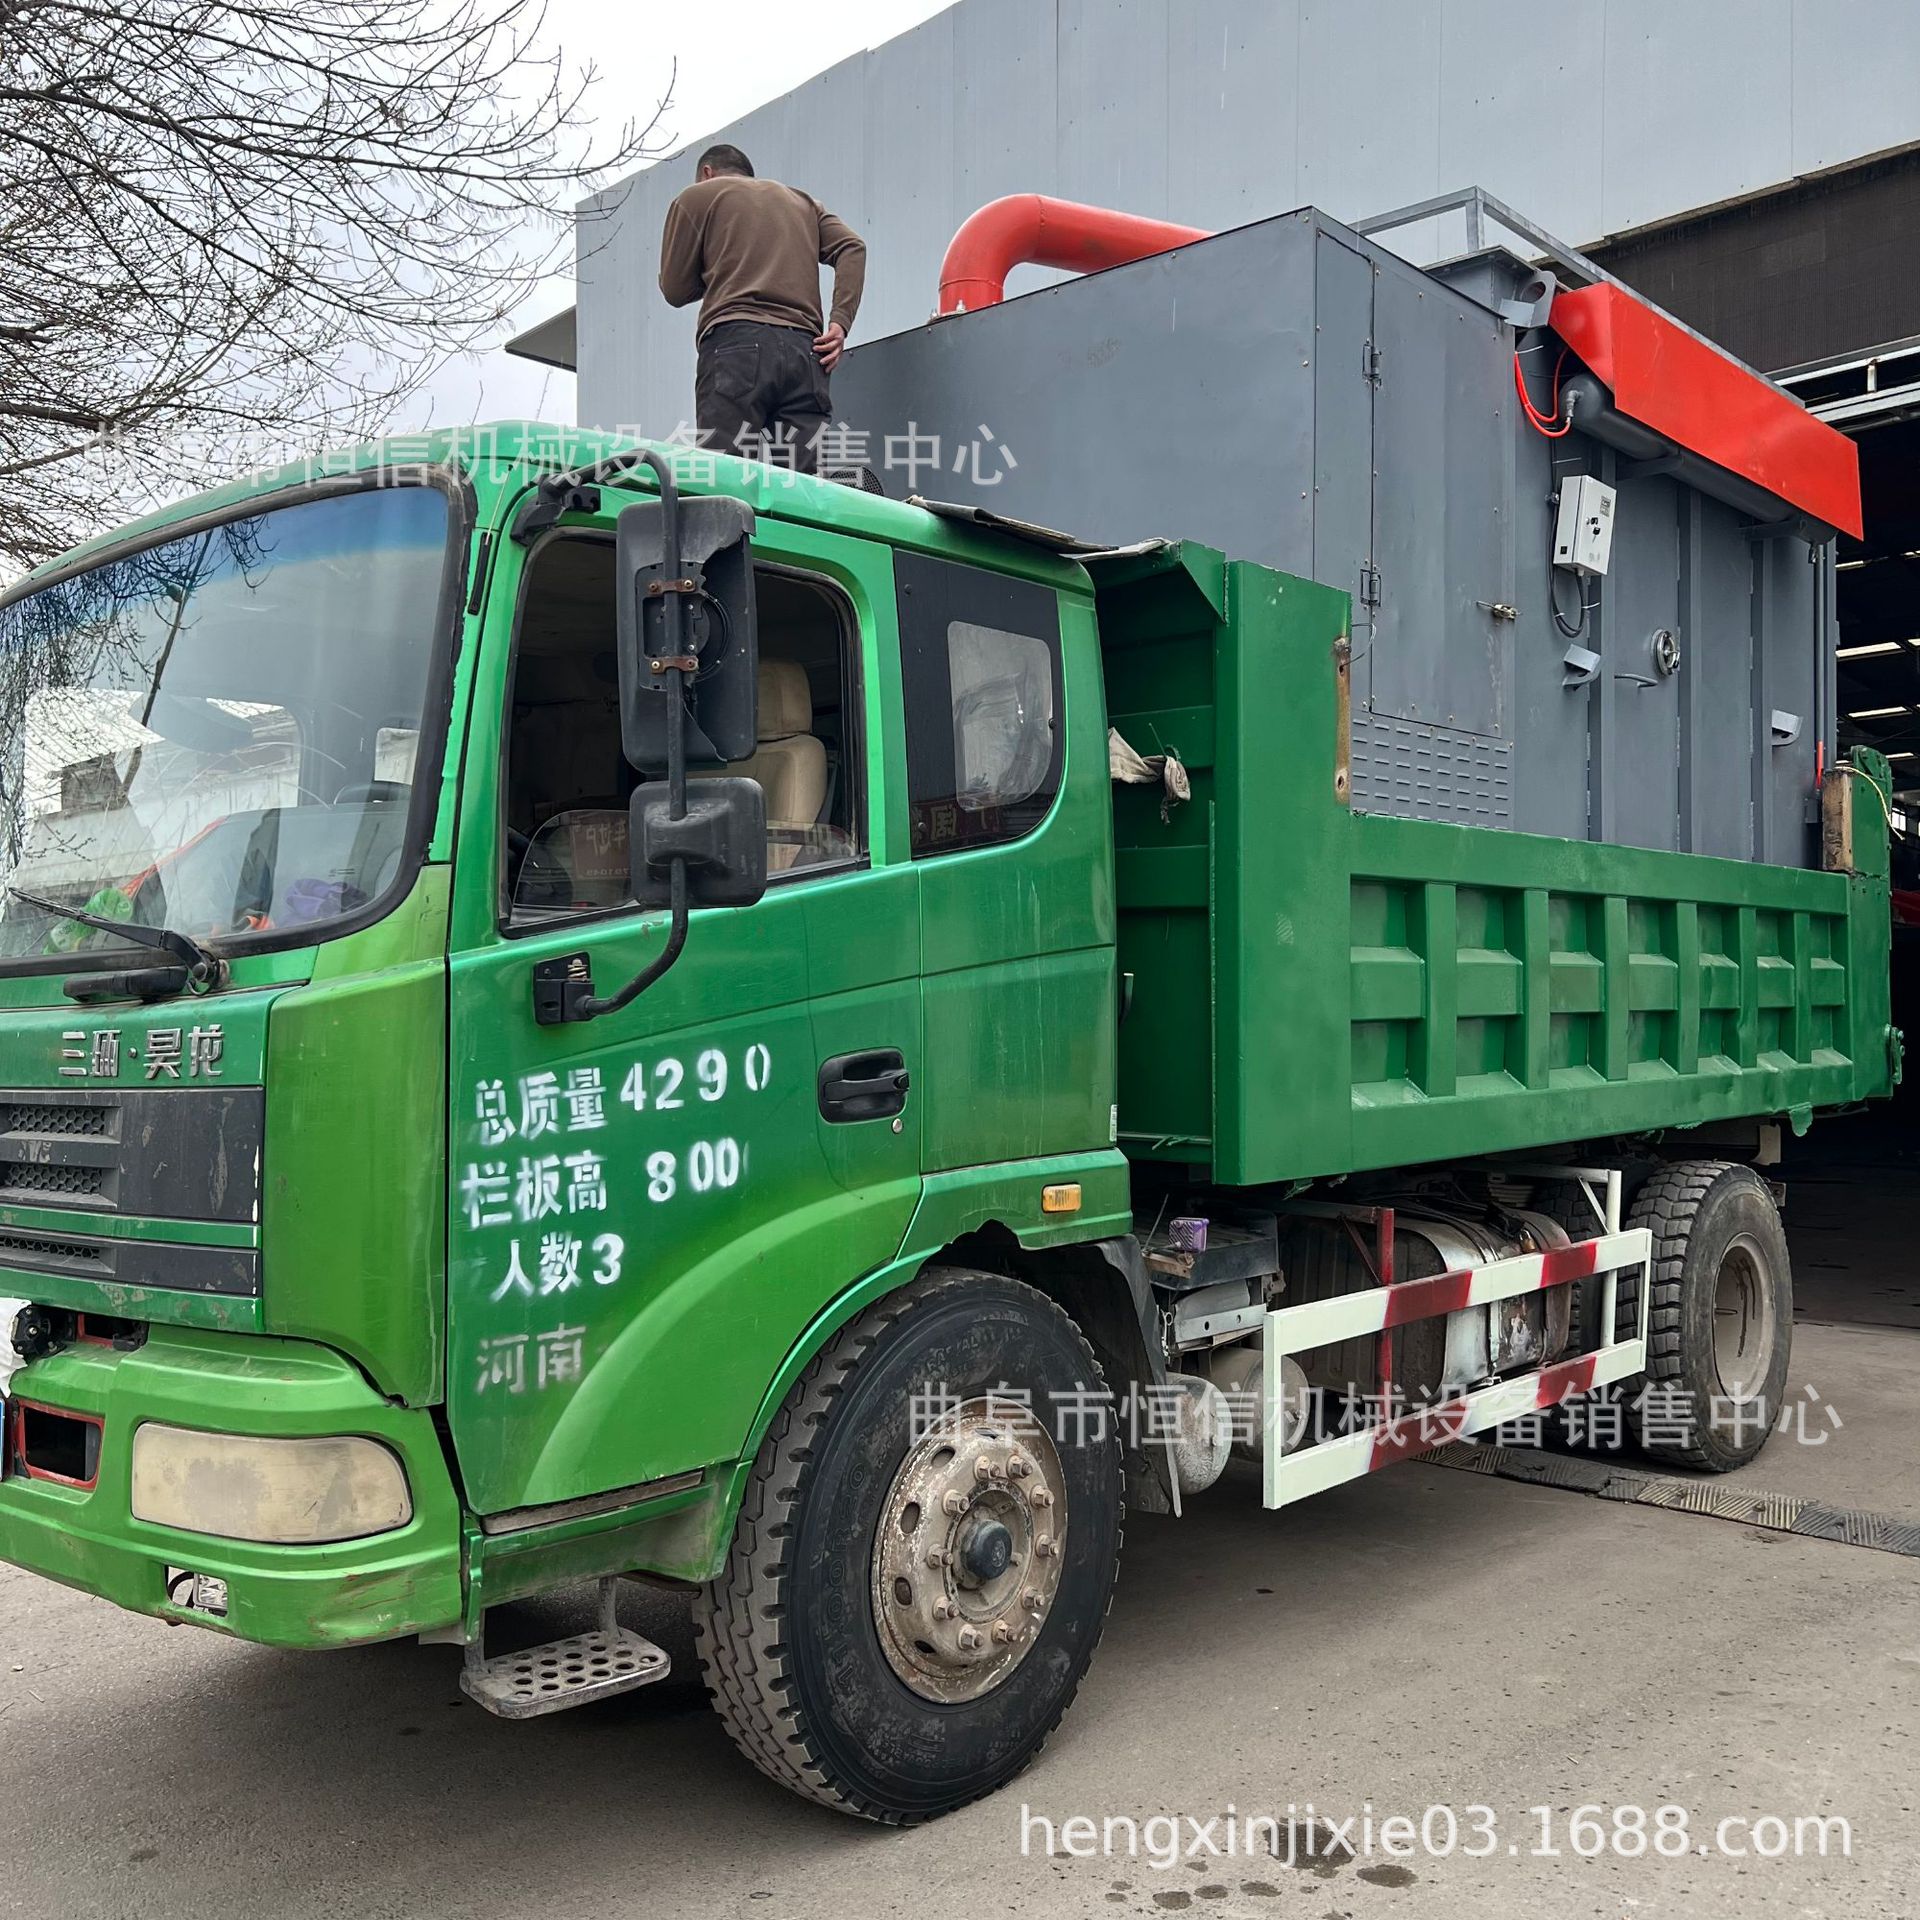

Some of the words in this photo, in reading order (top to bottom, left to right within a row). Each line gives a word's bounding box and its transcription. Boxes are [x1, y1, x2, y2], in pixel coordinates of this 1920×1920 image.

[475, 1066, 609, 1146] 总质量
[620, 1043, 771, 1111] 4290
[460, 1150, 608, 1229] 栏板高
[476, 1322, 587, 1394] 河南
